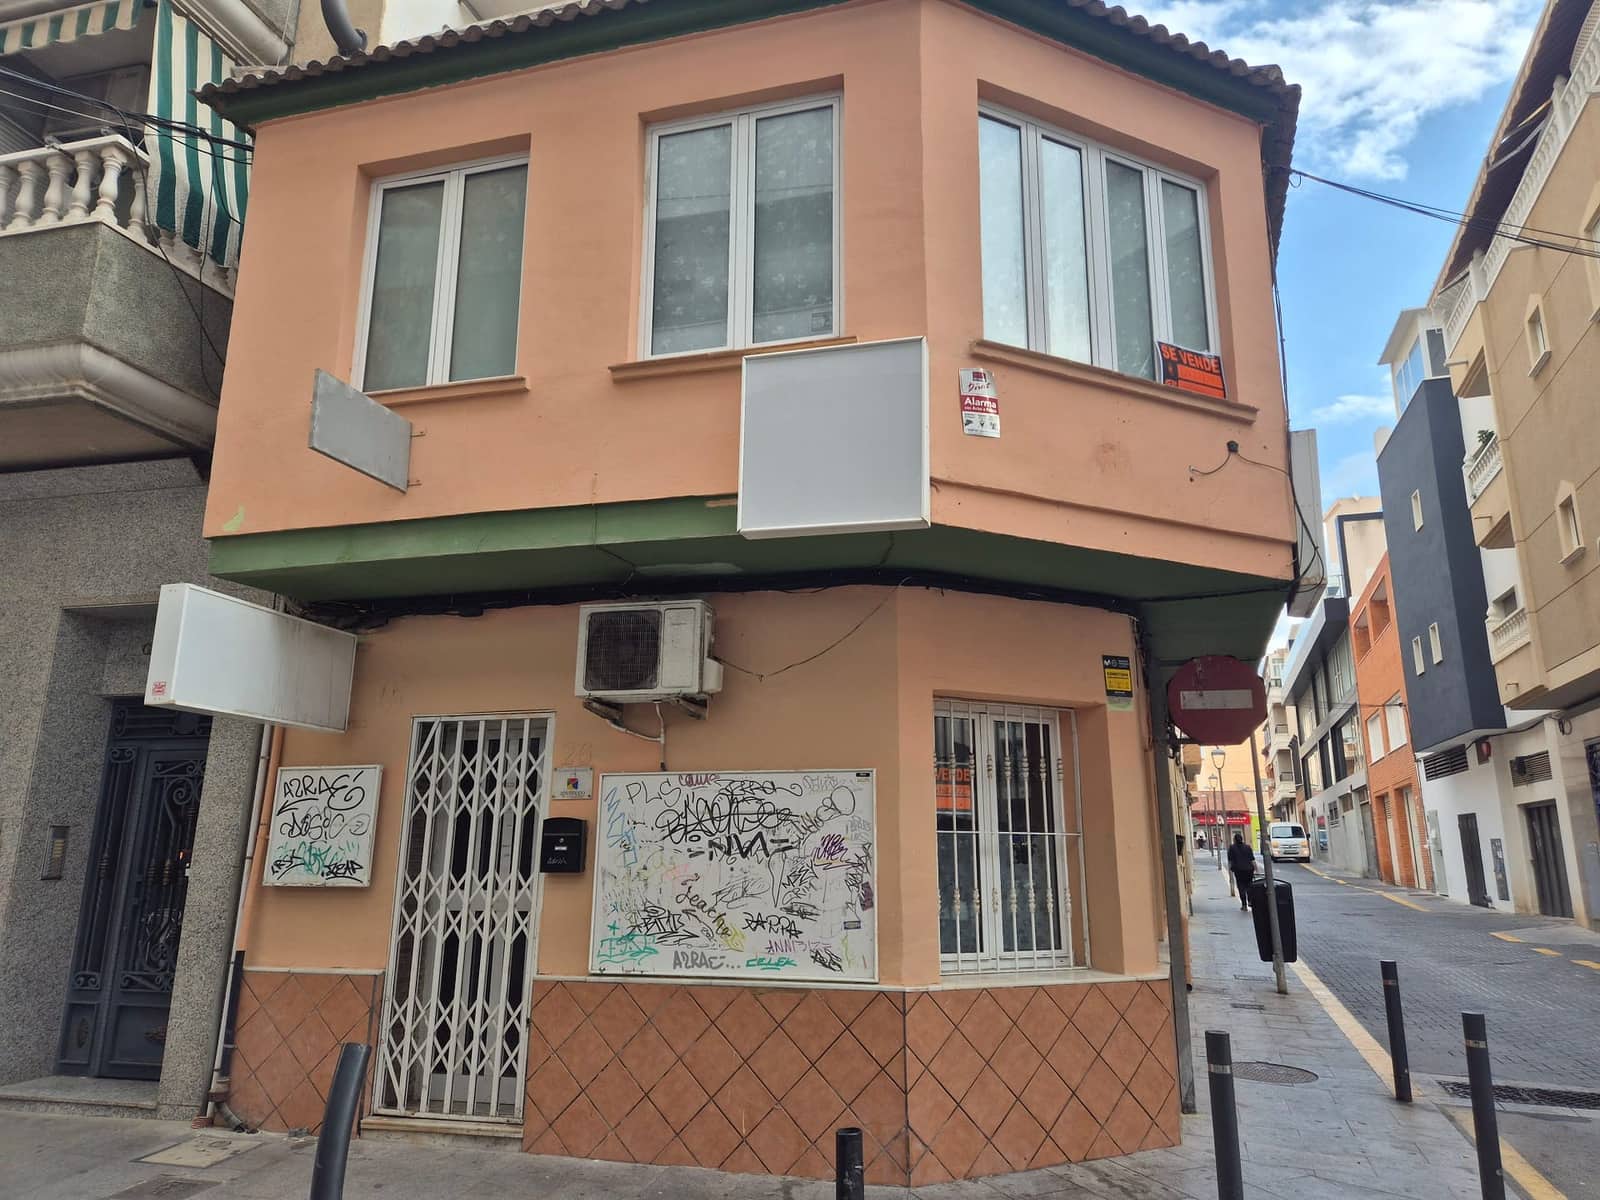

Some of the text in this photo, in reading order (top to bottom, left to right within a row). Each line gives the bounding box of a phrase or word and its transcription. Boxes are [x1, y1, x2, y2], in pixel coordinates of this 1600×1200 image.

[1160, 344, 1220, 373] SE VENDE
[964, 397, 997, 409] Alarma
[936, 768, 971, 782] VEDE
